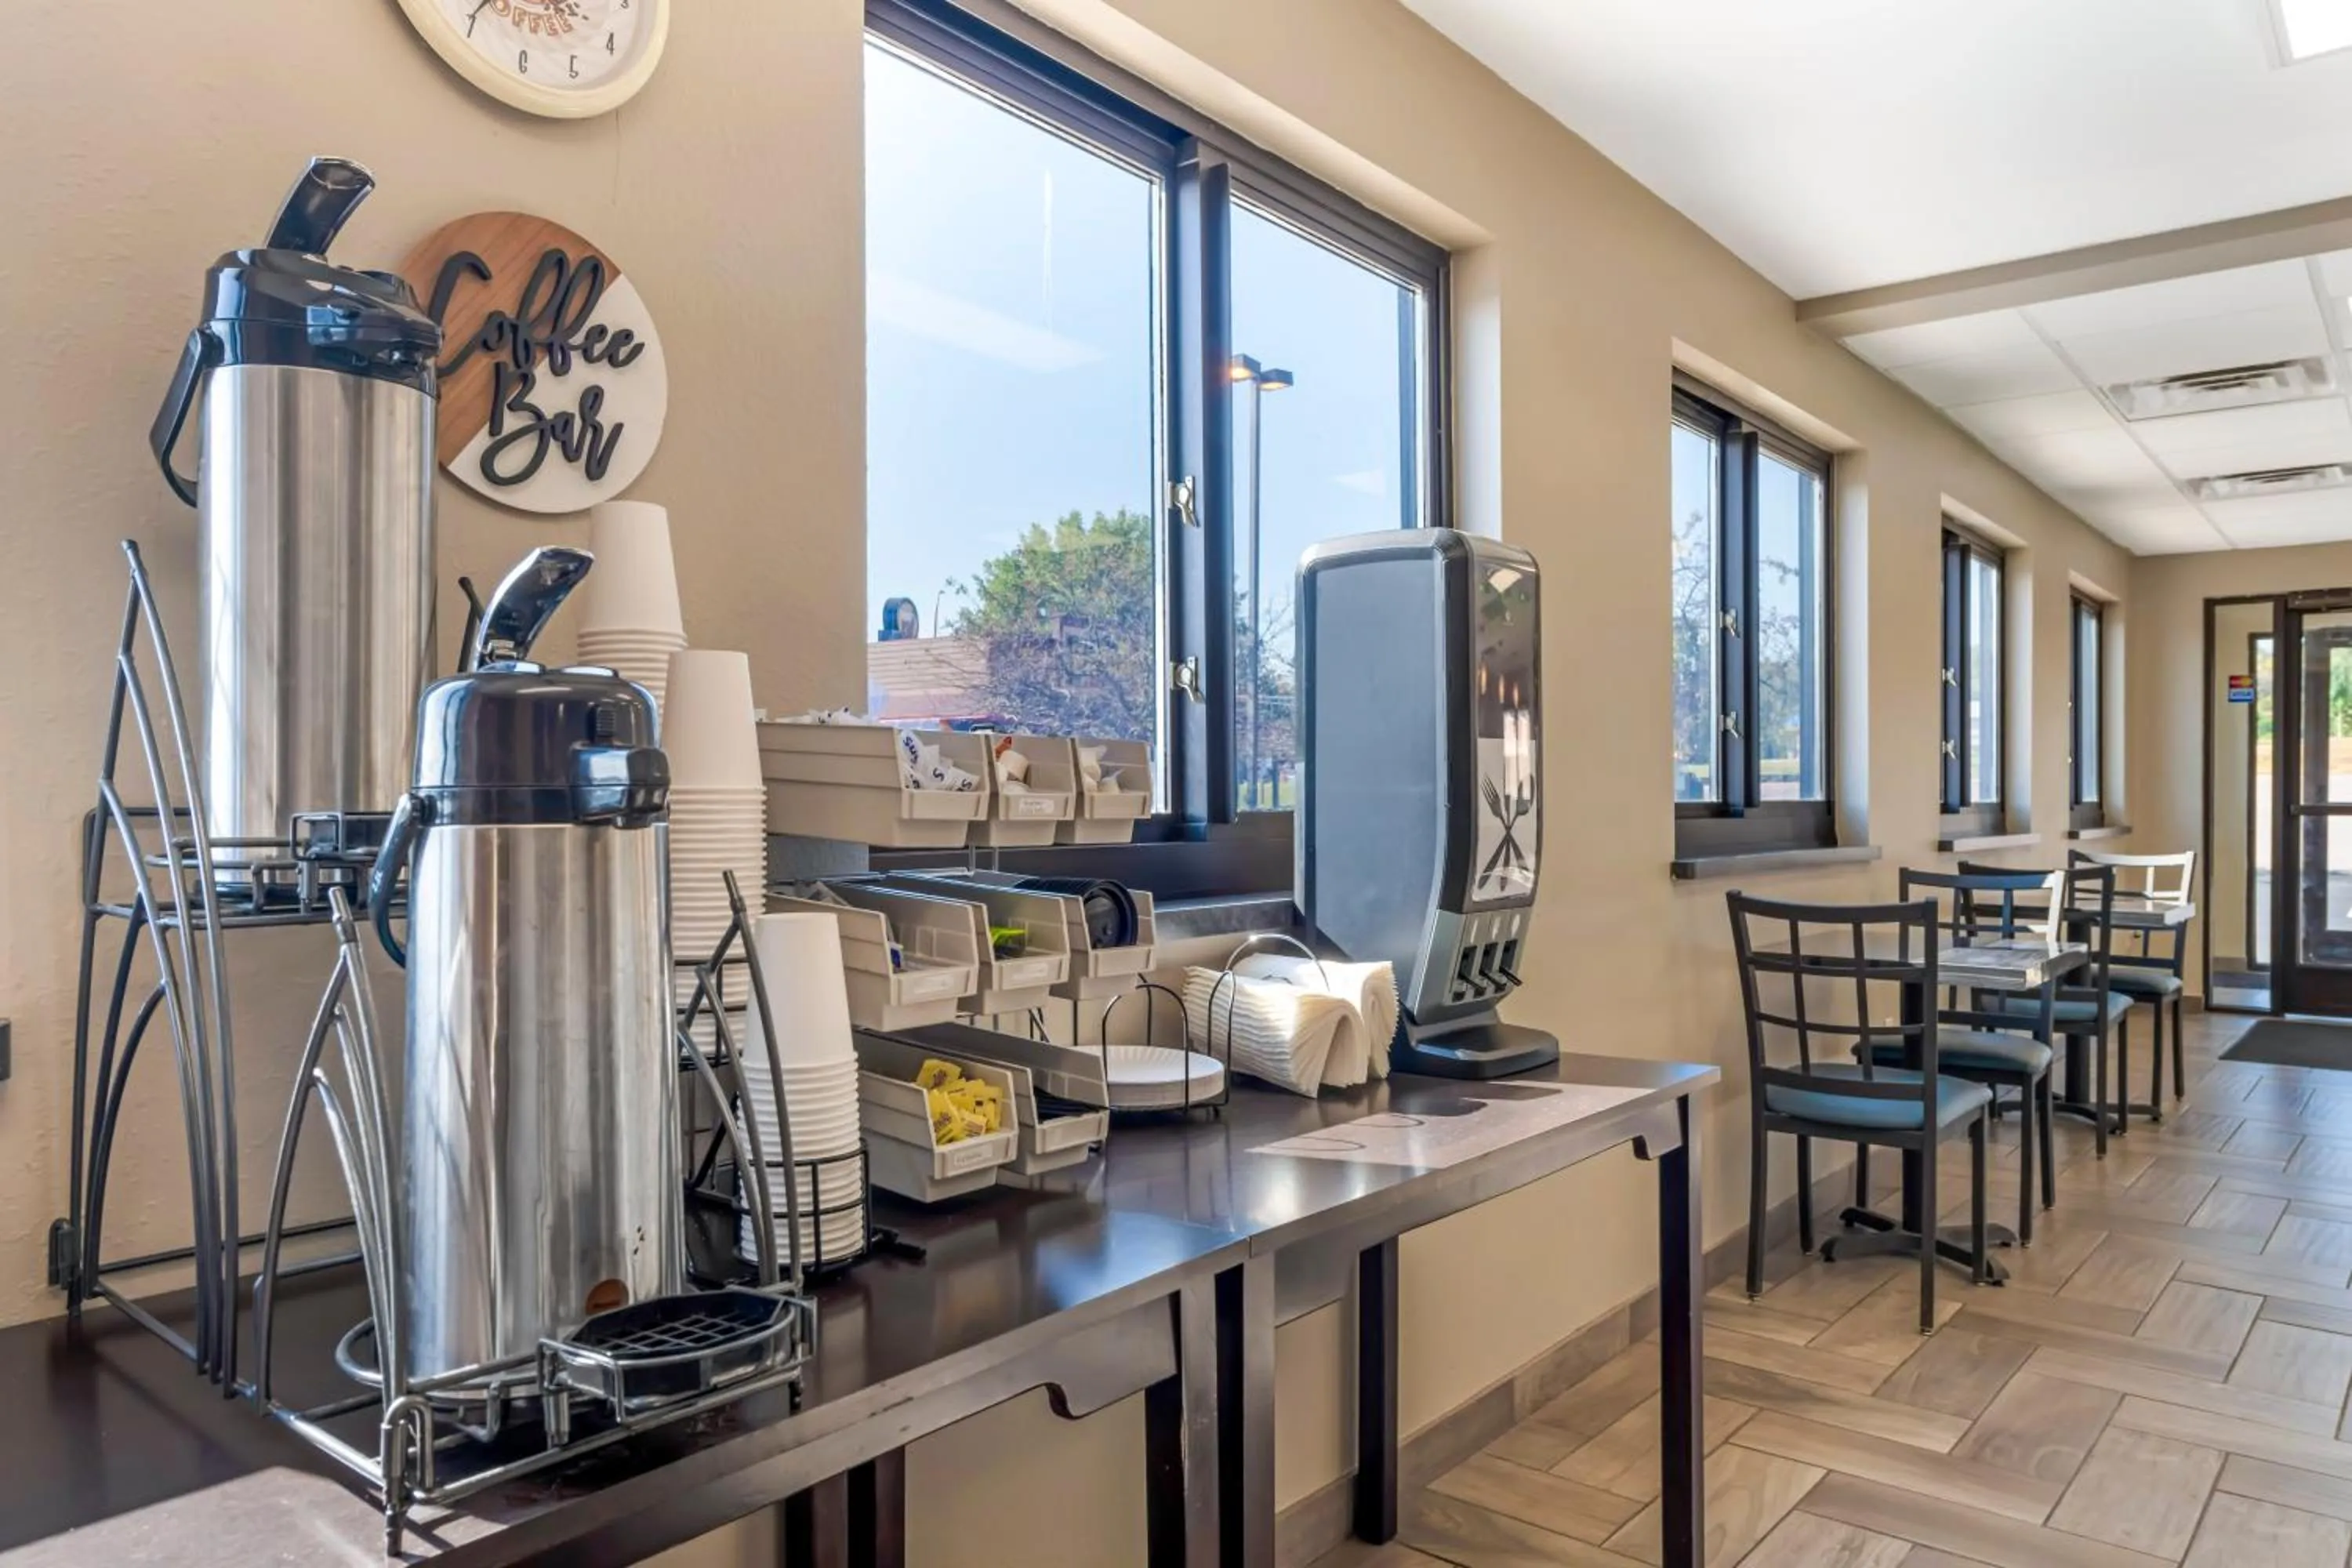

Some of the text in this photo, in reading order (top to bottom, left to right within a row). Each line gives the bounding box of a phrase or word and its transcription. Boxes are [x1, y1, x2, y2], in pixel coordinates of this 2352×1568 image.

[466, 13, 475, 38] 7
[490, 0, 573, 36] OFFEE
[605, 32, 615, 56] 4
[518, 49, 528, 74] 6
[568, 55, 579, 78] 5
[428, 248, 645, 379] Coffee
[479, 361, 625, 487] Bar
